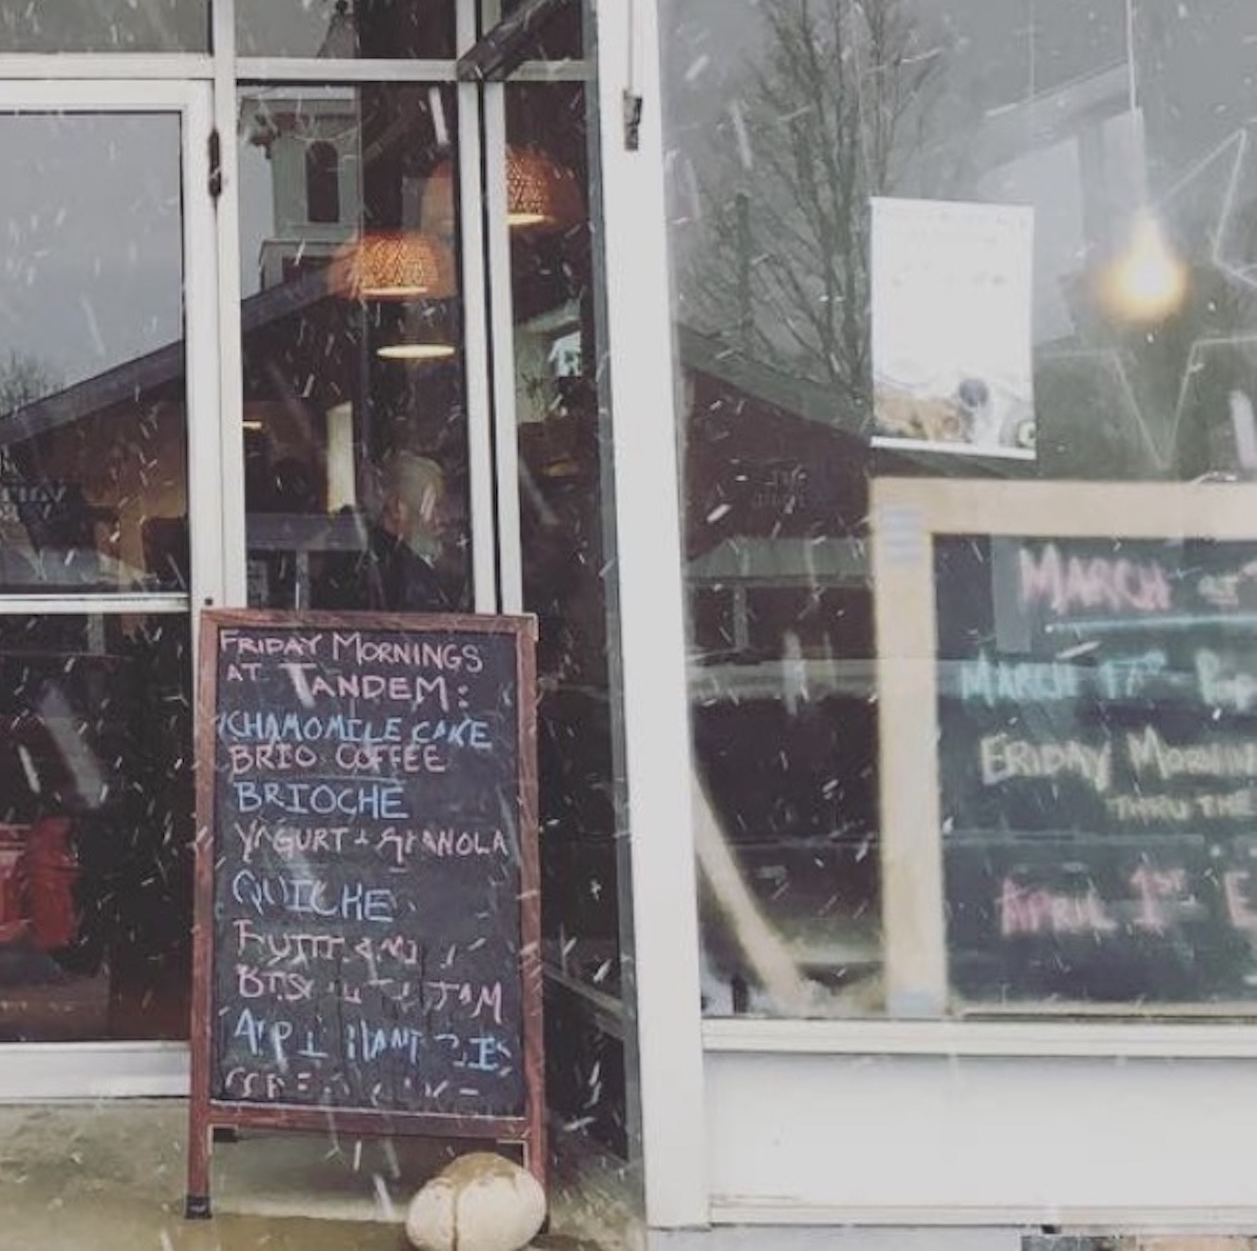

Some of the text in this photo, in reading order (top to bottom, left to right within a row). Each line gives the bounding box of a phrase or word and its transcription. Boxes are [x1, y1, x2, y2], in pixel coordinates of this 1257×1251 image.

[219, 629, 483, 674] FRIDAY MORNINGS
[226, 662, 263, 682] AT
[226, 710, 494, 749] CHAMOMILE CAKE
[229, 743, 446, 776] BRIO COFFEE
[233, 781, 410, 820] BRIOCHE
[231, 868, 395, 923] QUICHE
